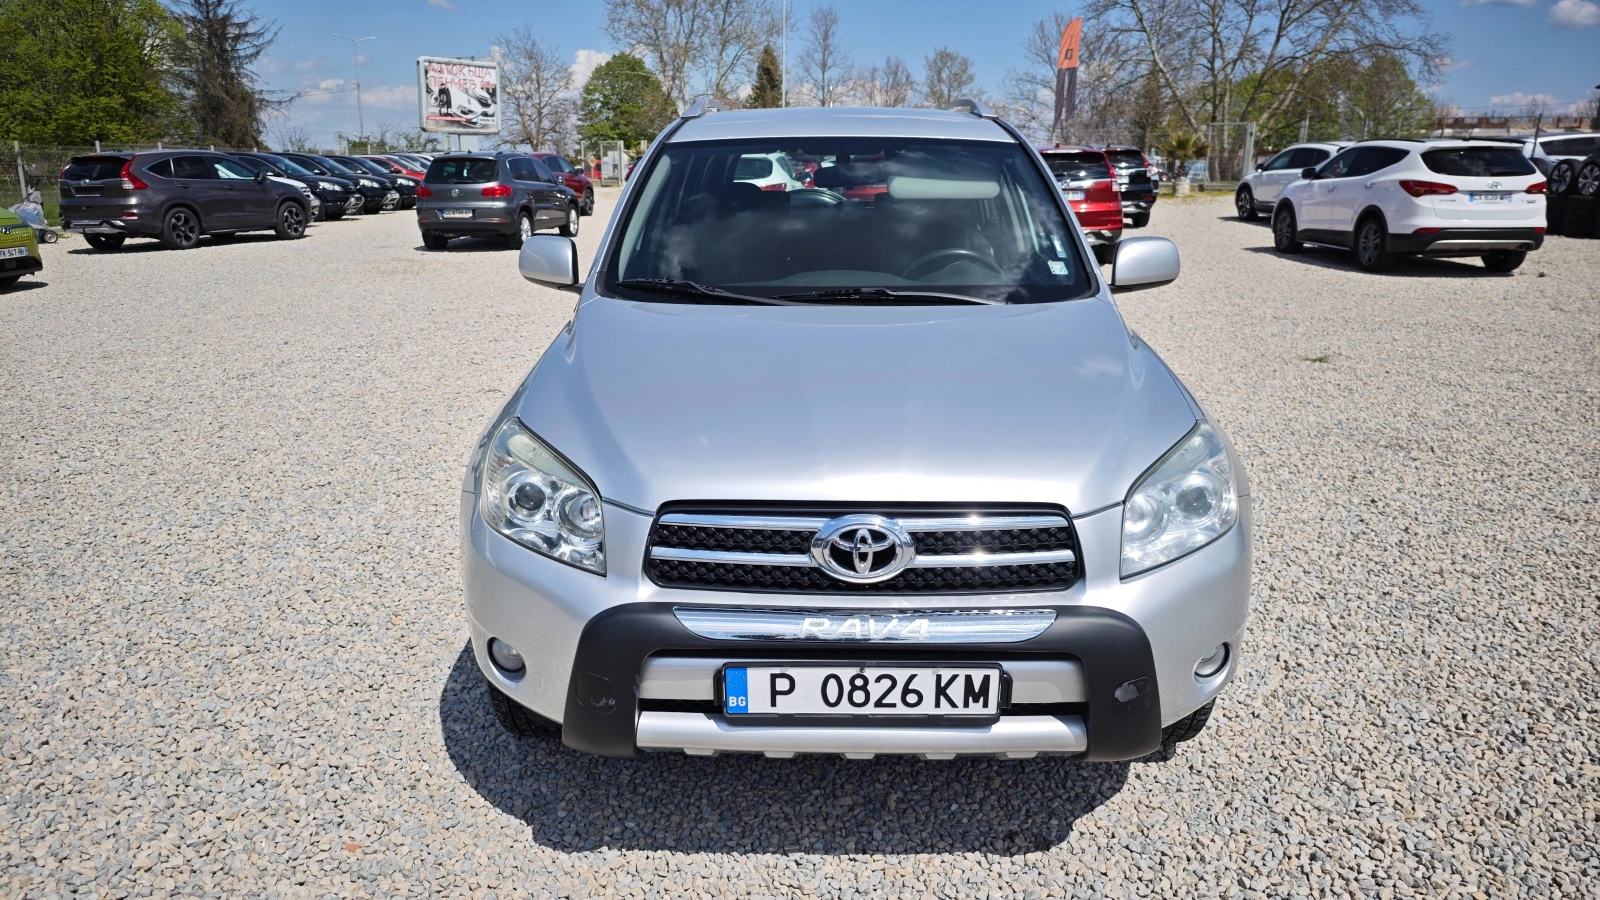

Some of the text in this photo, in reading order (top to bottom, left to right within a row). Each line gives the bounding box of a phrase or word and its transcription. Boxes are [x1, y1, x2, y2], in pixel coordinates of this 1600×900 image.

[801, 617, 930, 640] RAV4
[728, 696, 746, 707] BG
[770, 673, 991, 709] P 0826 KM
